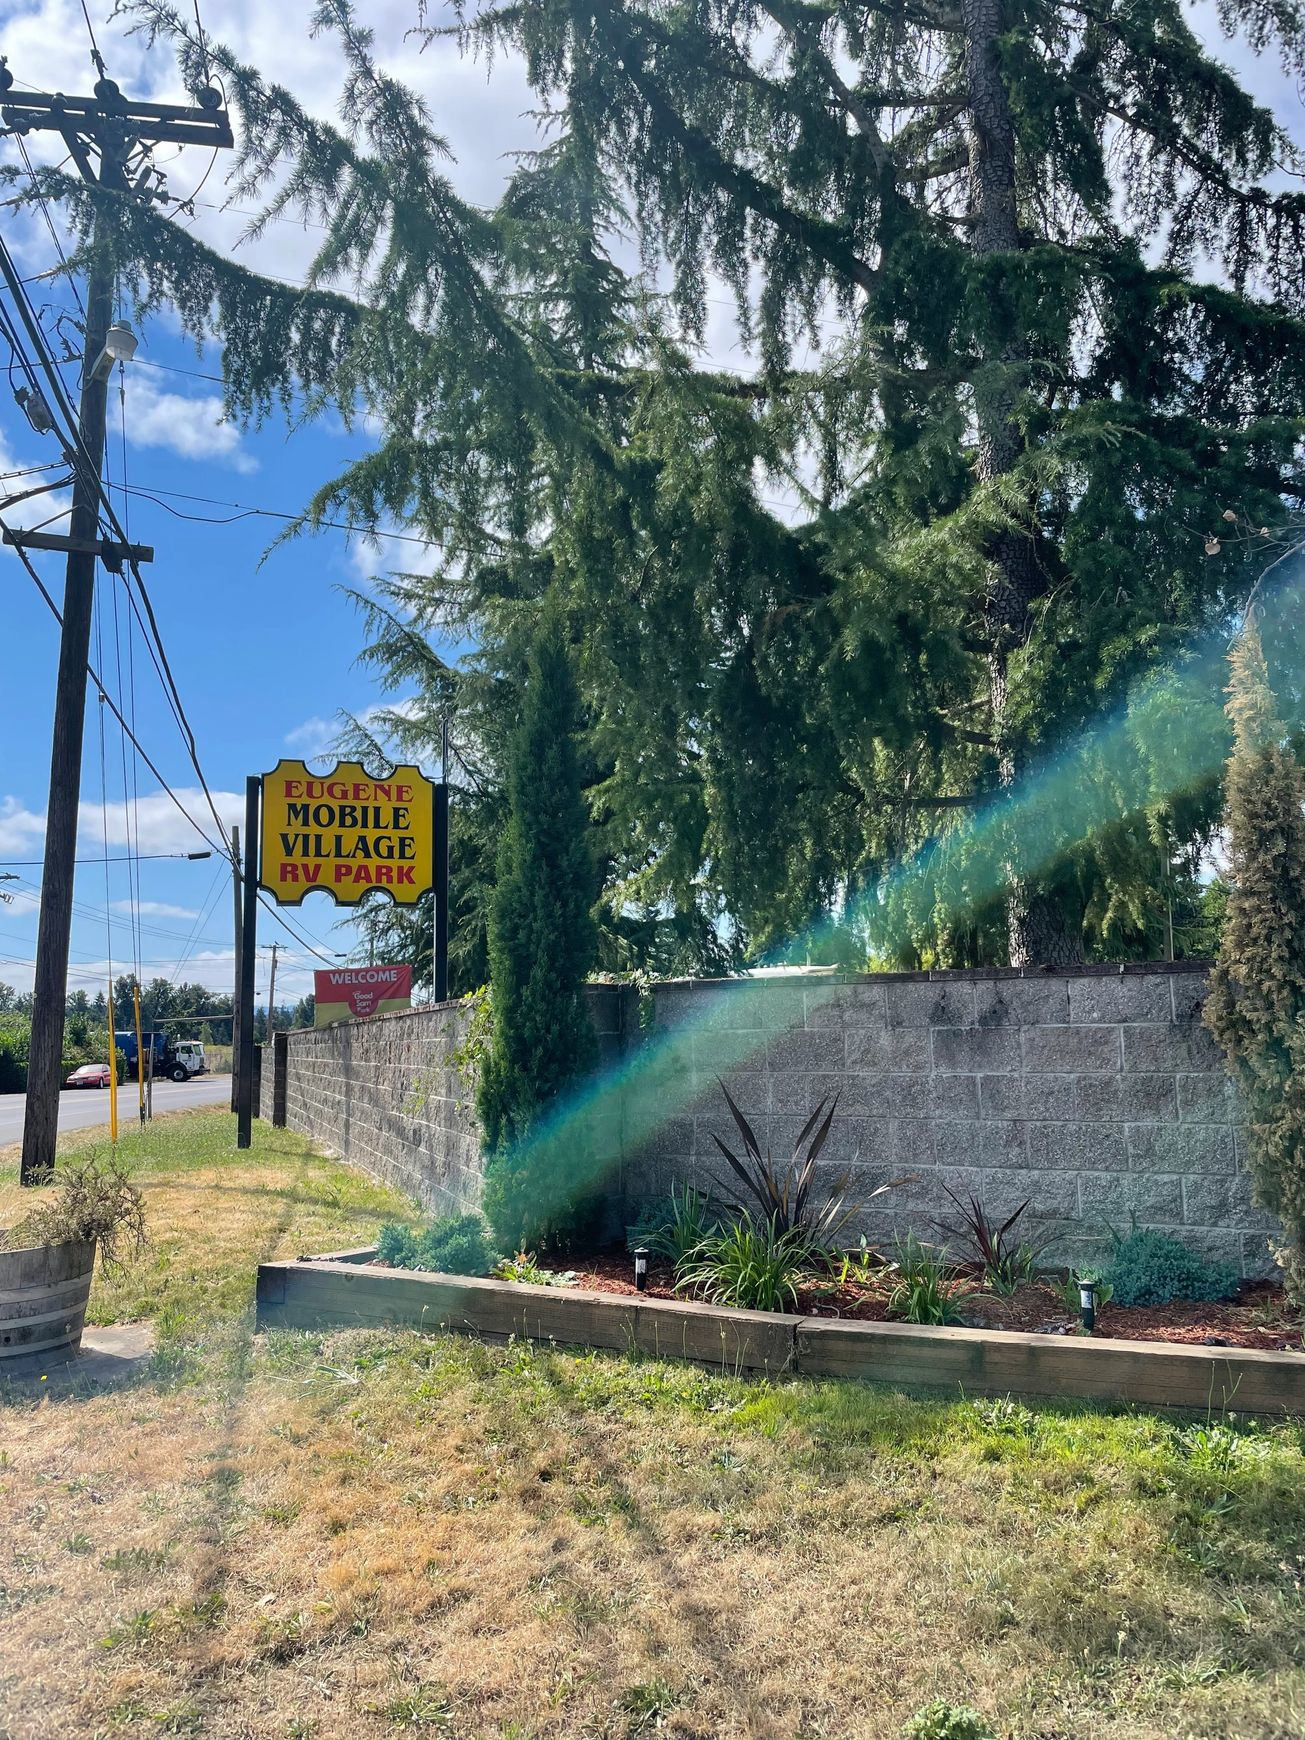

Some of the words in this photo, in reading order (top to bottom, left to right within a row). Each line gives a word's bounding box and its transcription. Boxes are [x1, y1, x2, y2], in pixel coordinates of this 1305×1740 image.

[284, 780, 414, 803] EUGENE
[286, 803, 411, 830] MOBILE
[279, 833, 417, 860] VILLAGE
[280, 862, 322, 883] RV
[334, 864, 416, 884] PARK
[329, 970, 398, 985] WELCOME
[353, 991, 373, 1000] Good
[356, 999, 372, 1007] Sam
